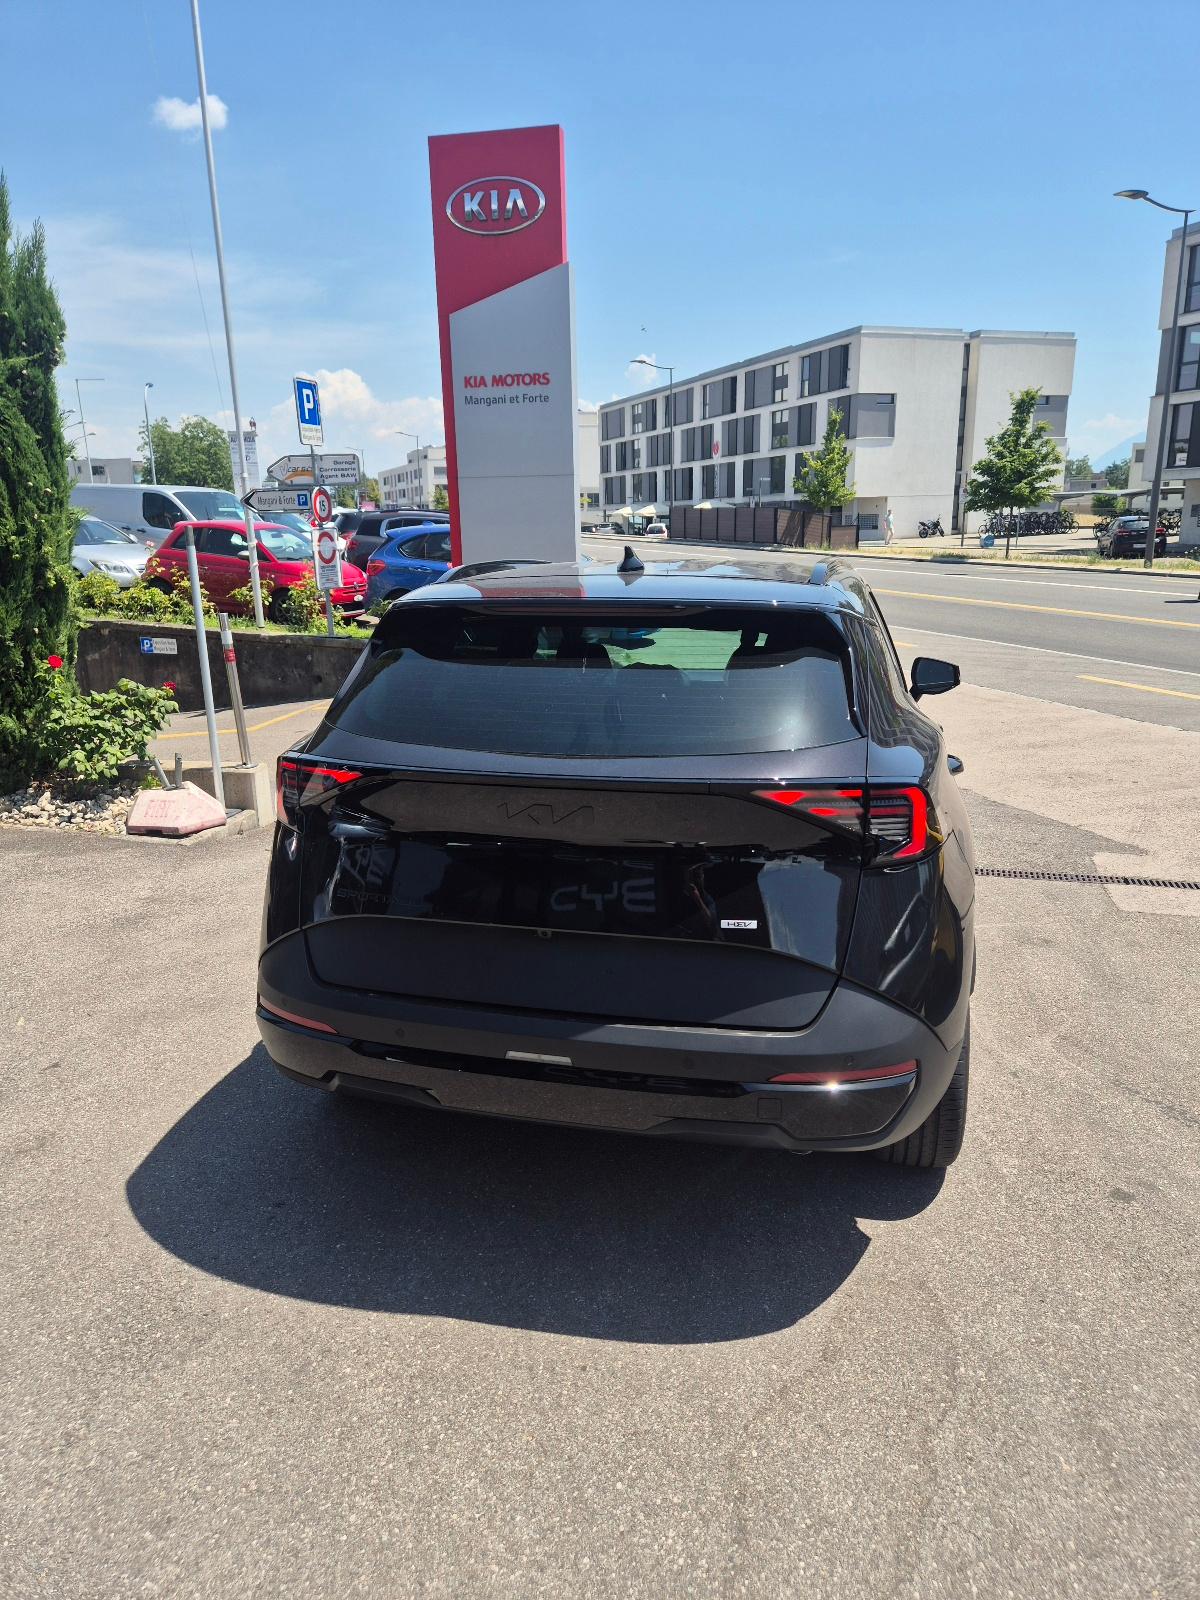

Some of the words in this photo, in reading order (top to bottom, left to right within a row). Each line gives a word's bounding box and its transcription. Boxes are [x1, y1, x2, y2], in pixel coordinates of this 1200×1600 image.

[463, 188, 529, 222] KIA
[463, 375, 488, 388] KIA
[490, 372, 550, 387] MOTORS
[302, 388, 314, 420] P
[464, 394, 507, 407] Mangani
[508, 393, 520, 405] et
[522, 392, 550, 404] Forte
[319, 473, 339, 481] Agent
[319, 500, 327, 512] 15
